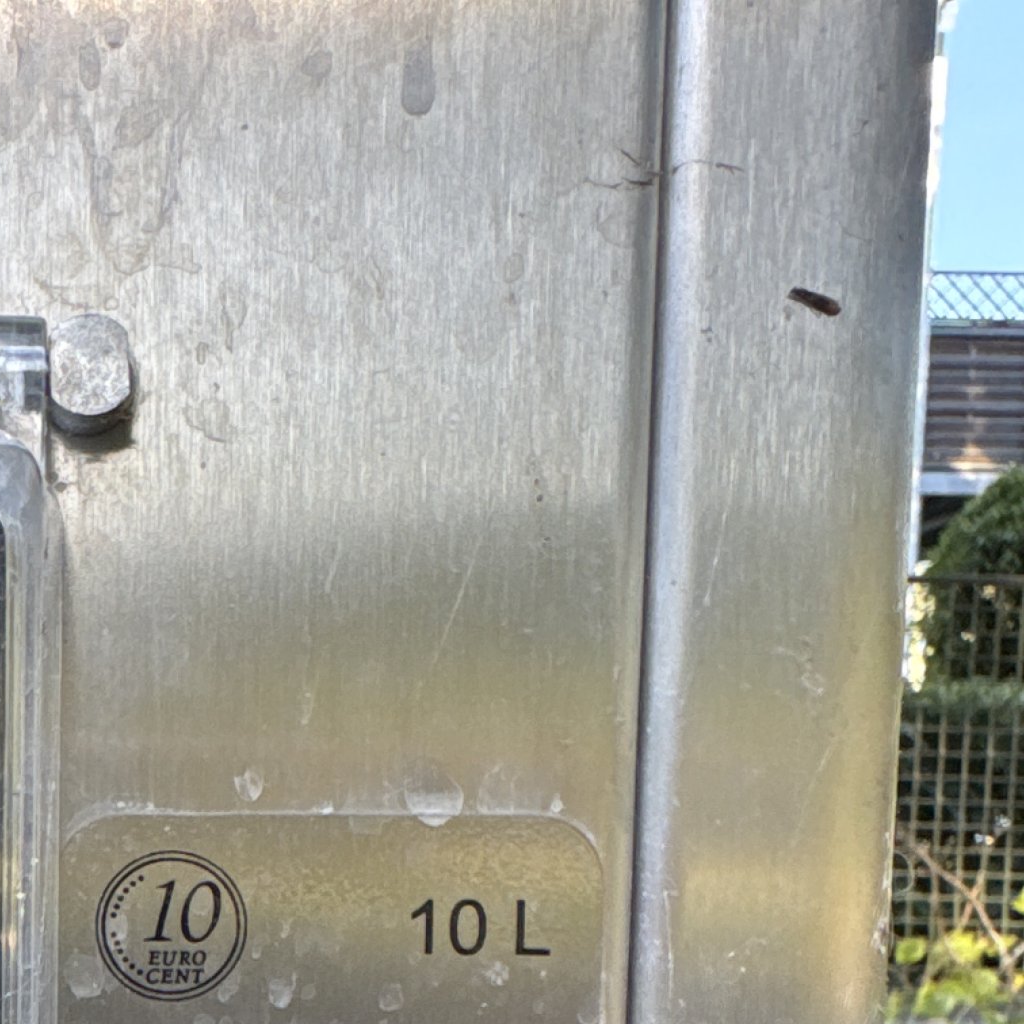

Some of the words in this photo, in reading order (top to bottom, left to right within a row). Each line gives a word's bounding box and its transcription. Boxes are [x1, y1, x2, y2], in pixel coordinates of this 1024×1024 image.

[143, 880, 222, 943] 10
[410, 898, 488, 956] 10
[515, 899, 551, 956] L
[146, 967, 205, 985] CENT
[148, 949, 207, 966] EURO
